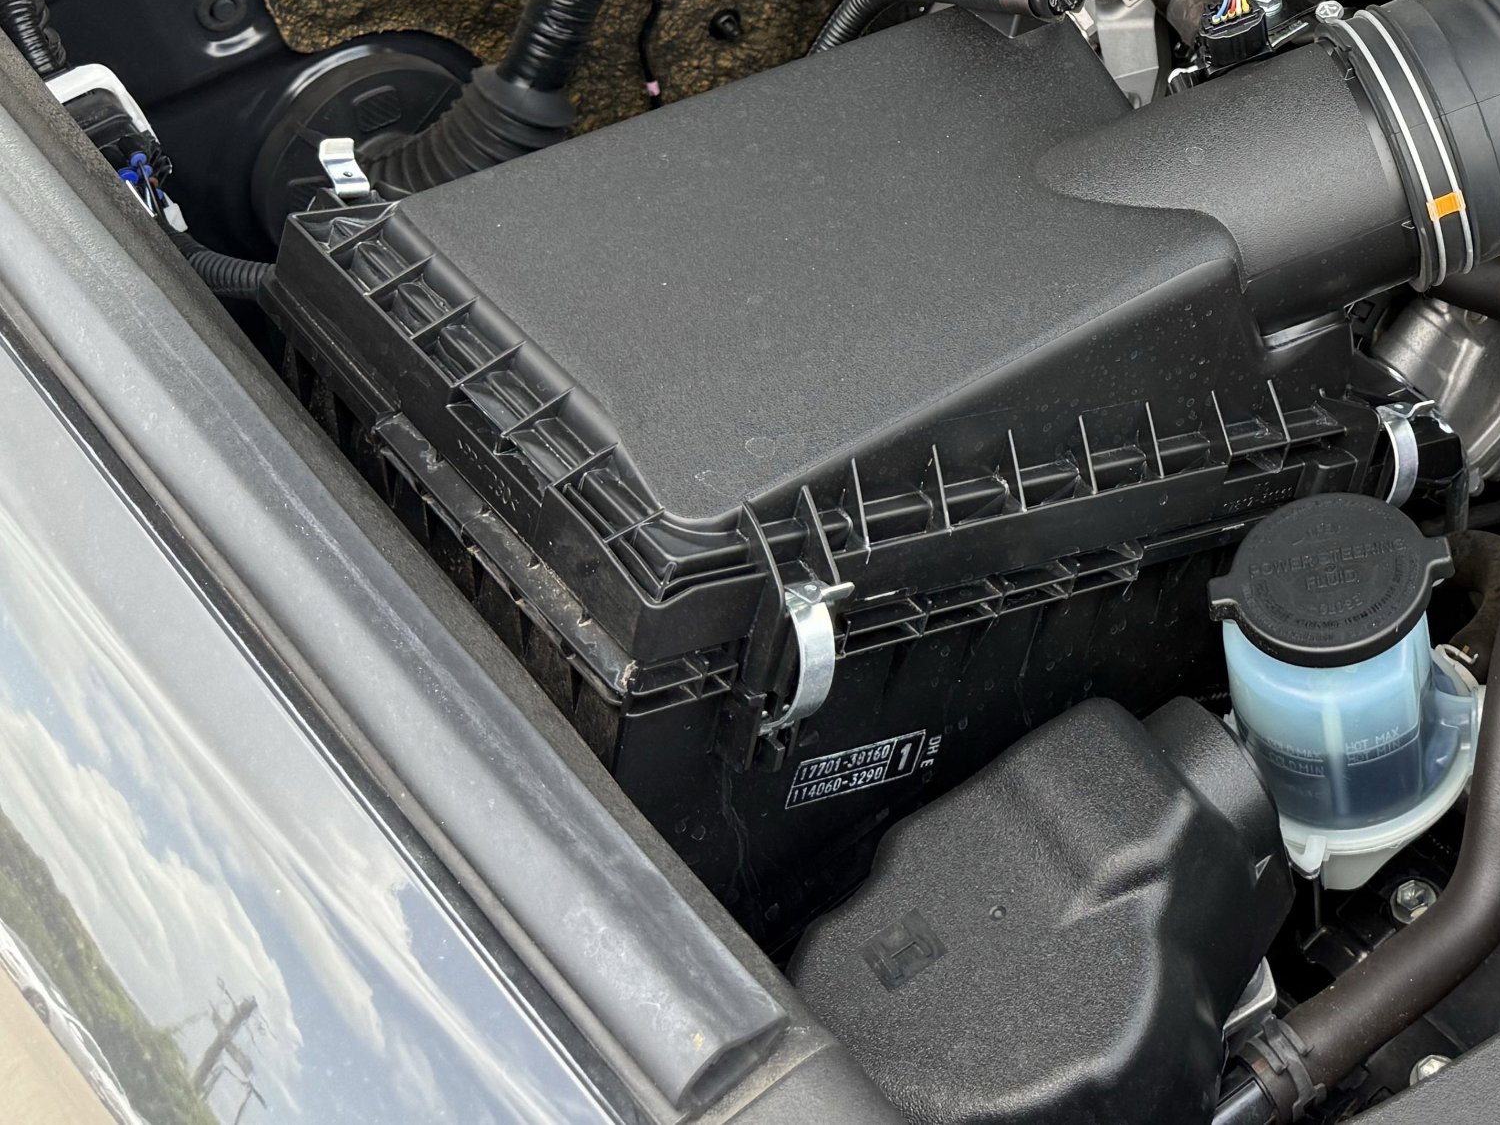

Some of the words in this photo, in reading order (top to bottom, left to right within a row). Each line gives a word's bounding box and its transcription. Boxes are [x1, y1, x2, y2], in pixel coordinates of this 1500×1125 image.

[1249, 555, 1314, 578] POWER
[1317, 538, 1407, 565] STEERING
[1304, 569, 1358, 591] FLUID
[1344, 738, 1369, 753] HOT
[1375, 726, 1401, 743] MAX
[1346, 751, 1370, 763] HOT
[1380, 740, 1402, 755] MIN
[897, 743, 912, 771] 1
[1299, 761, 1324, 776] MIN
[792, 766, 884, 803] 114060-3290
